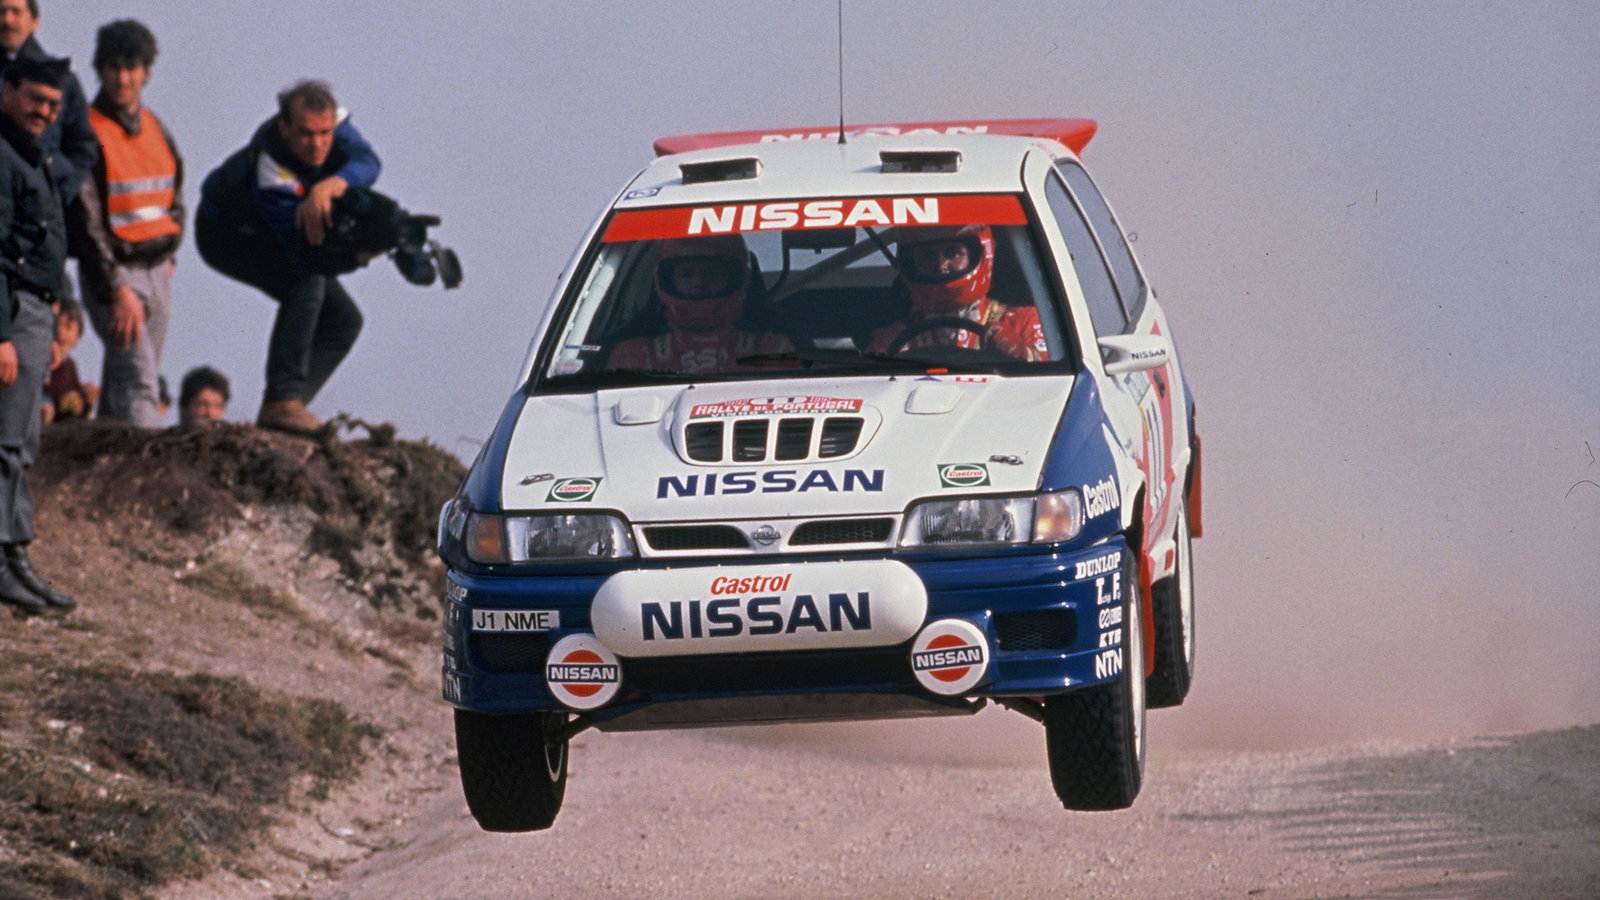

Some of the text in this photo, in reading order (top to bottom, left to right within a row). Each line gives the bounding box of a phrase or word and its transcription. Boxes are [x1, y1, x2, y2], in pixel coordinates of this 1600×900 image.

[687, 198, 939, 234] NISSAN
[1131, 349, 1166, 360] NISSAN
[695, 404, 751, 416] RALLYE
[772, 400, 857, 411] PORTUGAL
[657, 469, 884, 499] NISSAN
[1083, 474, 1120, 519] Castrol
[1075, 551, 1121, 580] DUNLOP
[711, 573, 792, 595] Castrol
[477, 612, 495, 629] J1
[504, 612, 550, 630] NME
[641, 592, 872, 641] NISSAN
[916, 649, 981, 668] NISSAN
[1095, 648, 1122, 679] NTN
[551, 667, 614, 680] NISSAN
